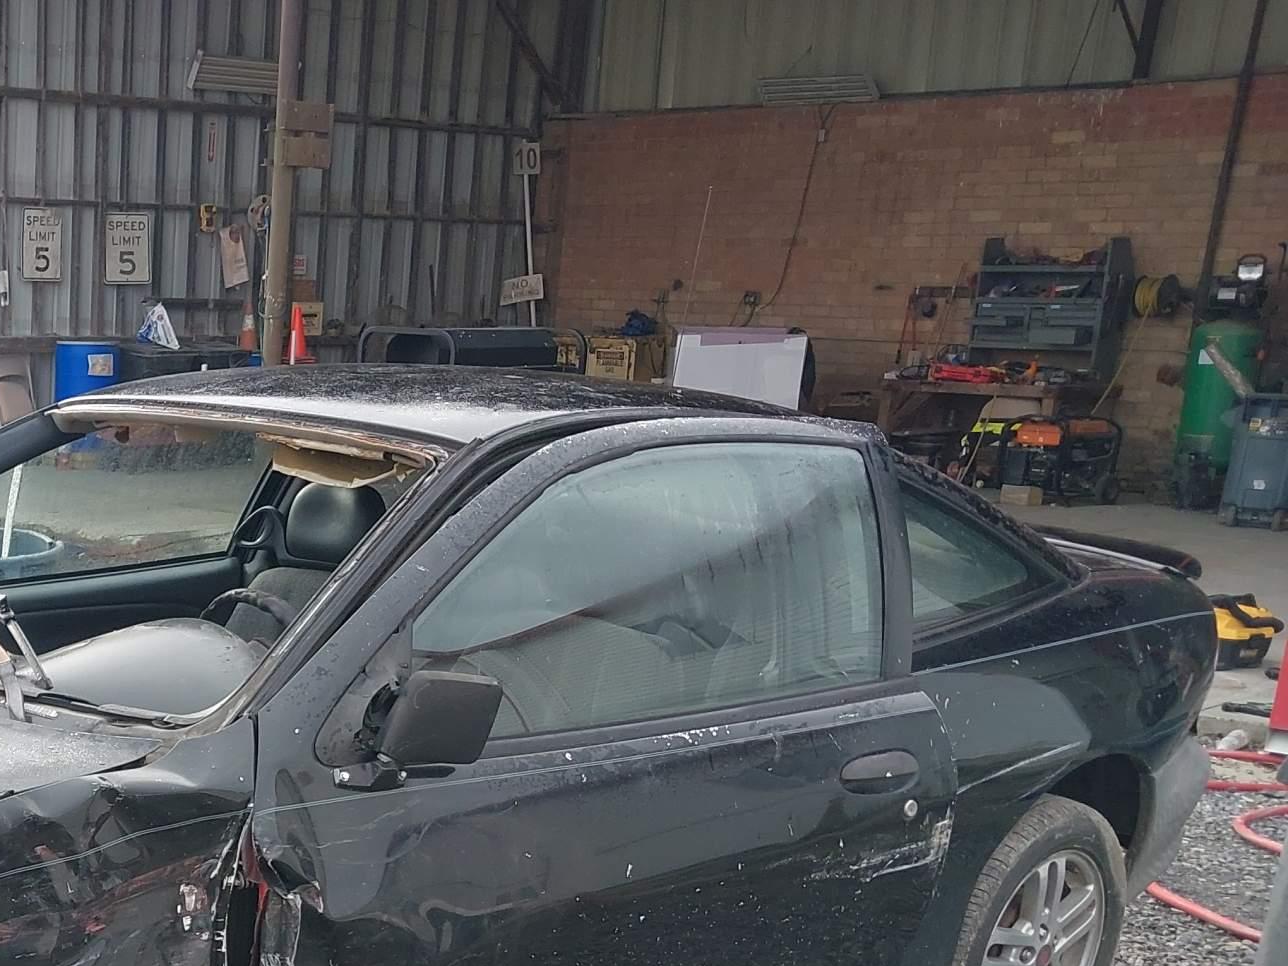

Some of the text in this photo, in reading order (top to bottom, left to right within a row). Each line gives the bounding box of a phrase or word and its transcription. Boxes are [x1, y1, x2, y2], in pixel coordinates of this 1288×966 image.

[515, 147, 537, 170] 10
[26, 215, 62, 226] SPEED
[107, 220, 146, 232] SPEED
[28, 231, 57, 242] LIMIT
[112, 235, 142, 247] LIMIT
[34, 246, 51, 273] 5
[118, 250, 137, 276] 5
[512, 279, 529, 290] NO
